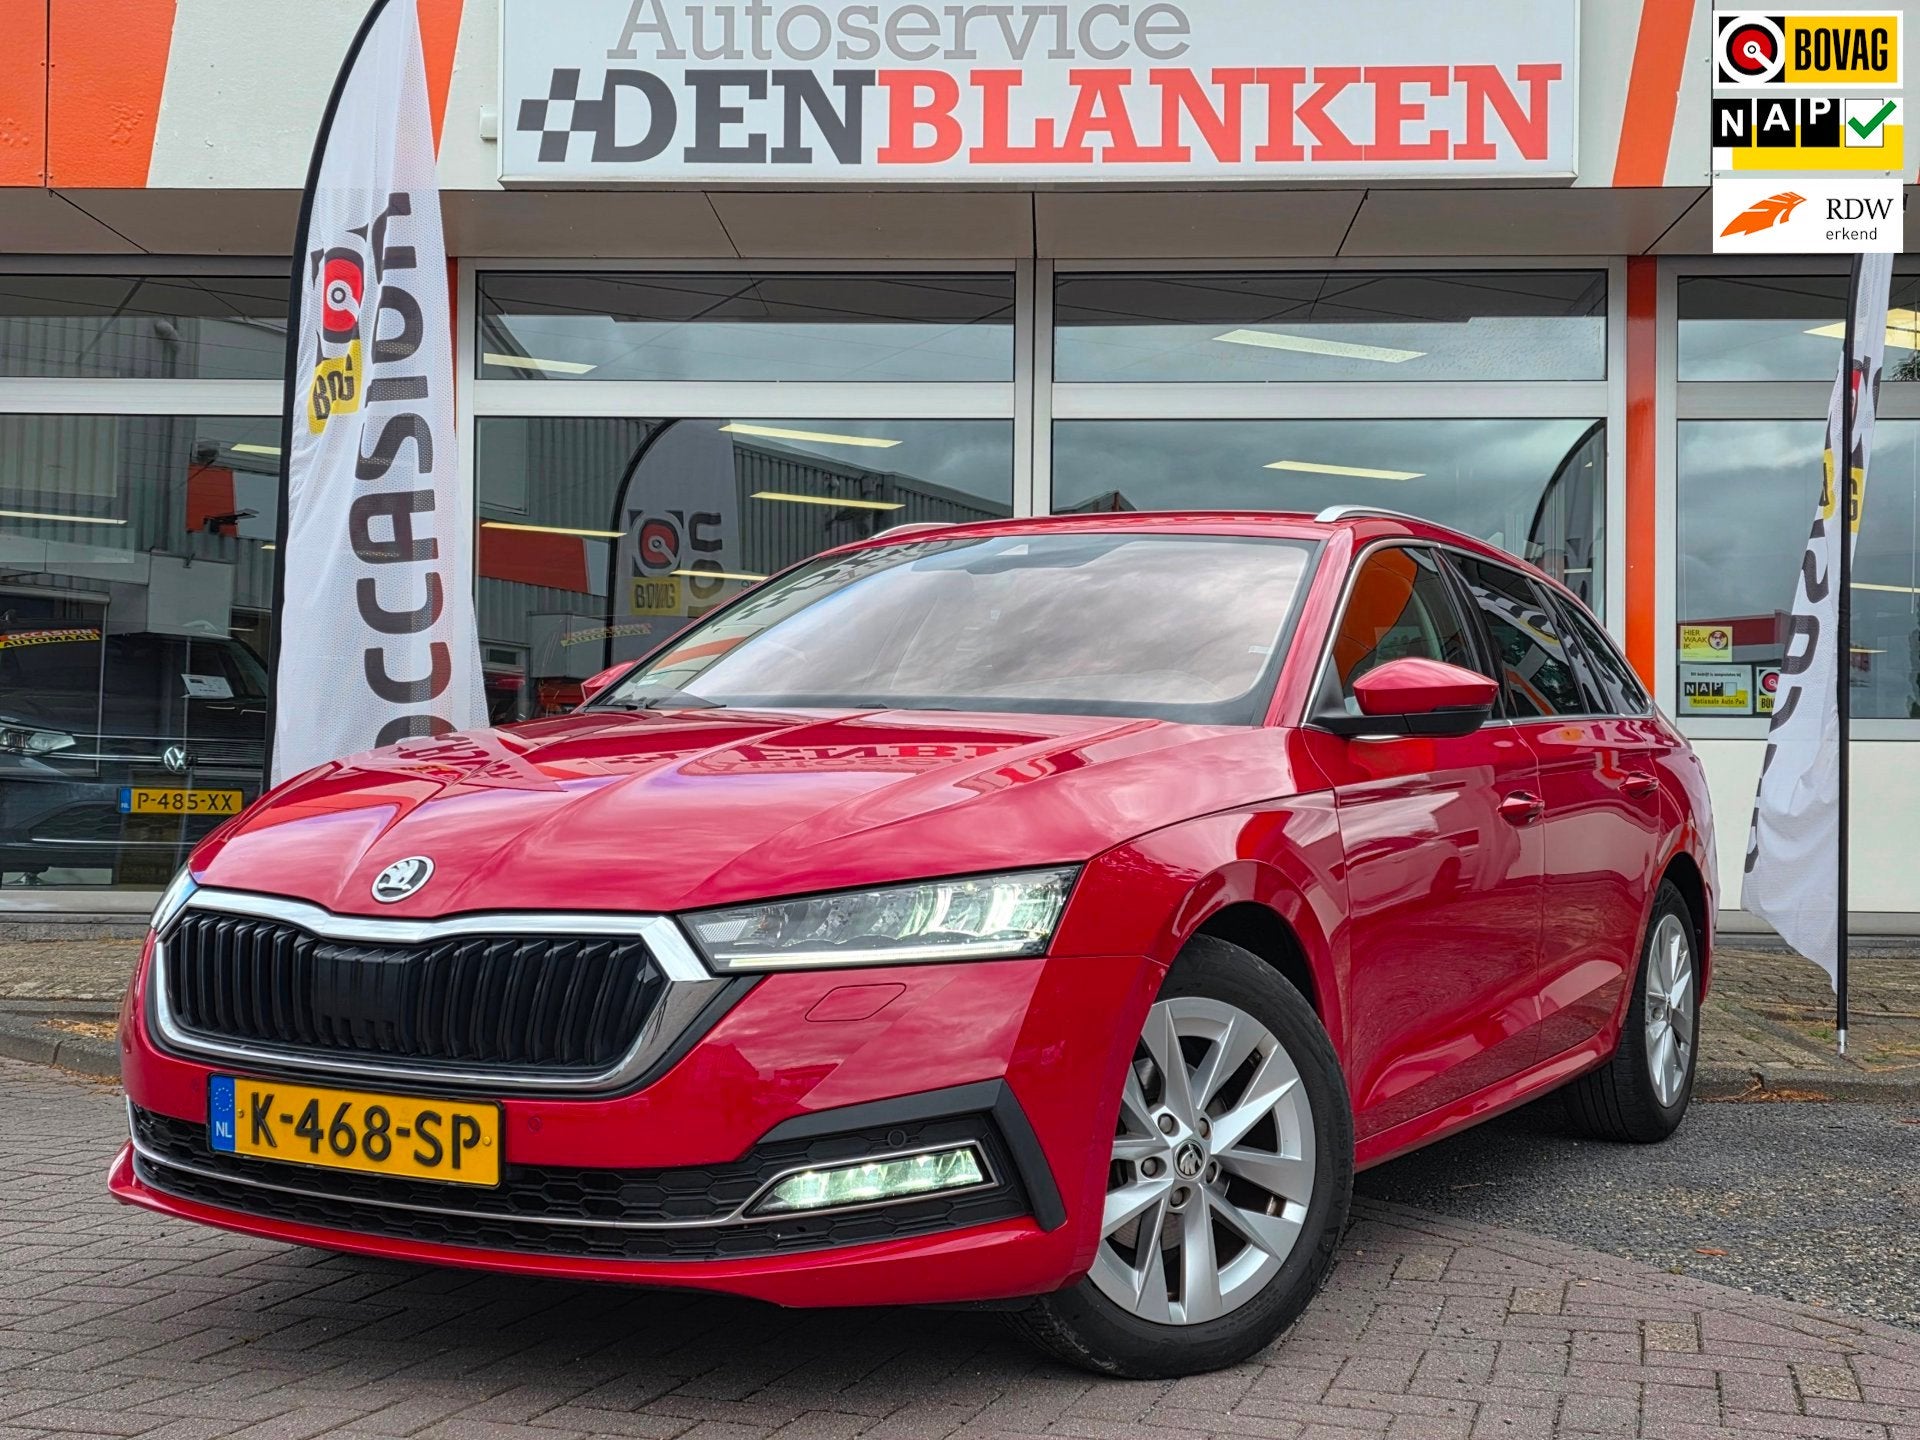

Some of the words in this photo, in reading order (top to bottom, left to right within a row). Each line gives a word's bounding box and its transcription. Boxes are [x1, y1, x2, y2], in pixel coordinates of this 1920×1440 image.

[606, 0, 1190, 61] Autoservice
[1686, 683, 1722, 694] NAP
[138, 792, 233, 811] P-485-XX
[215, 1121, 232, 1139] NL
[250, 1091, 482, 1170] K-468-SP
